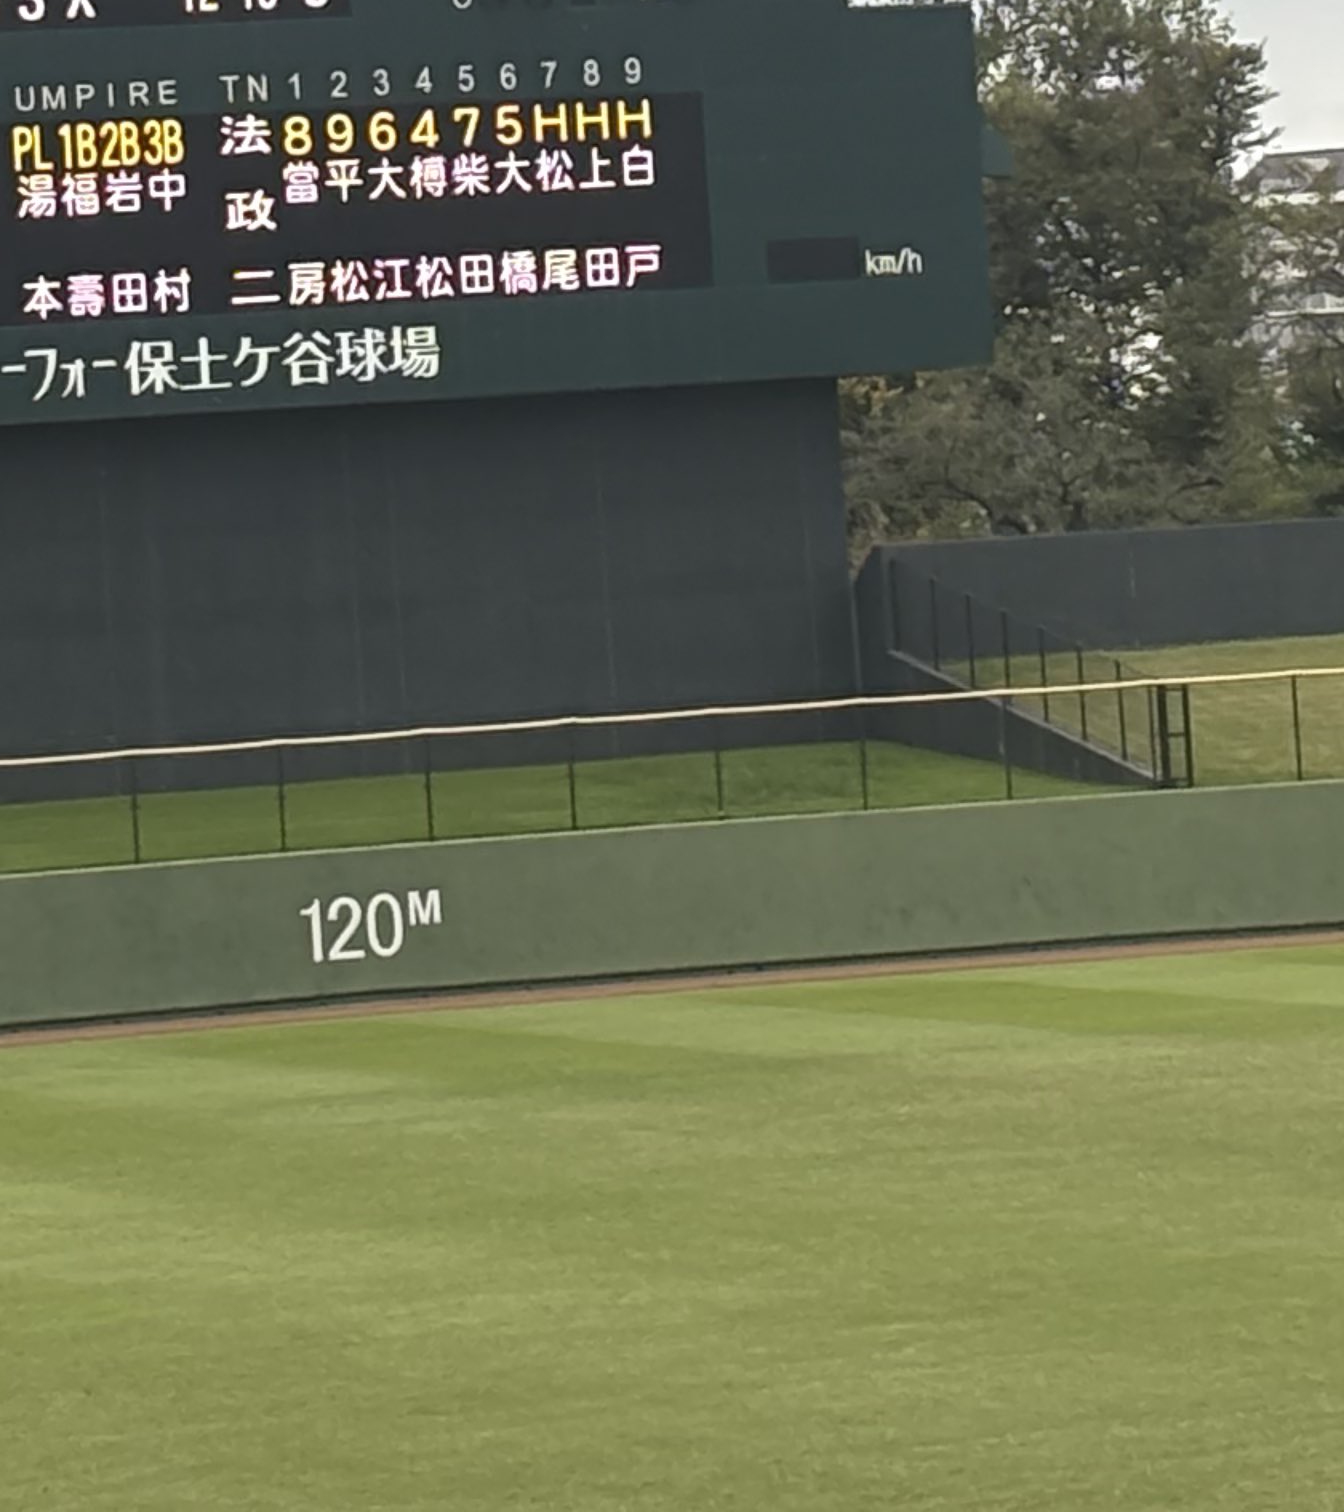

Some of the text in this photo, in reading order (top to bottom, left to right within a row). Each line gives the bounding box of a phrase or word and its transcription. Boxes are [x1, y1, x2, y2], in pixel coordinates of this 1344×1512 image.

[15, 80, 177, 111] UMPIRE
[220, 57, 640, 103] TN 1 2 3 4 5 6 7 8 9
[12, 119, 185, 171] PL 1B 2B 3B
[284, 99, 651, 155] 8 9 6 4 7 5 H H H
[865, 247, 922, 275] km/h
